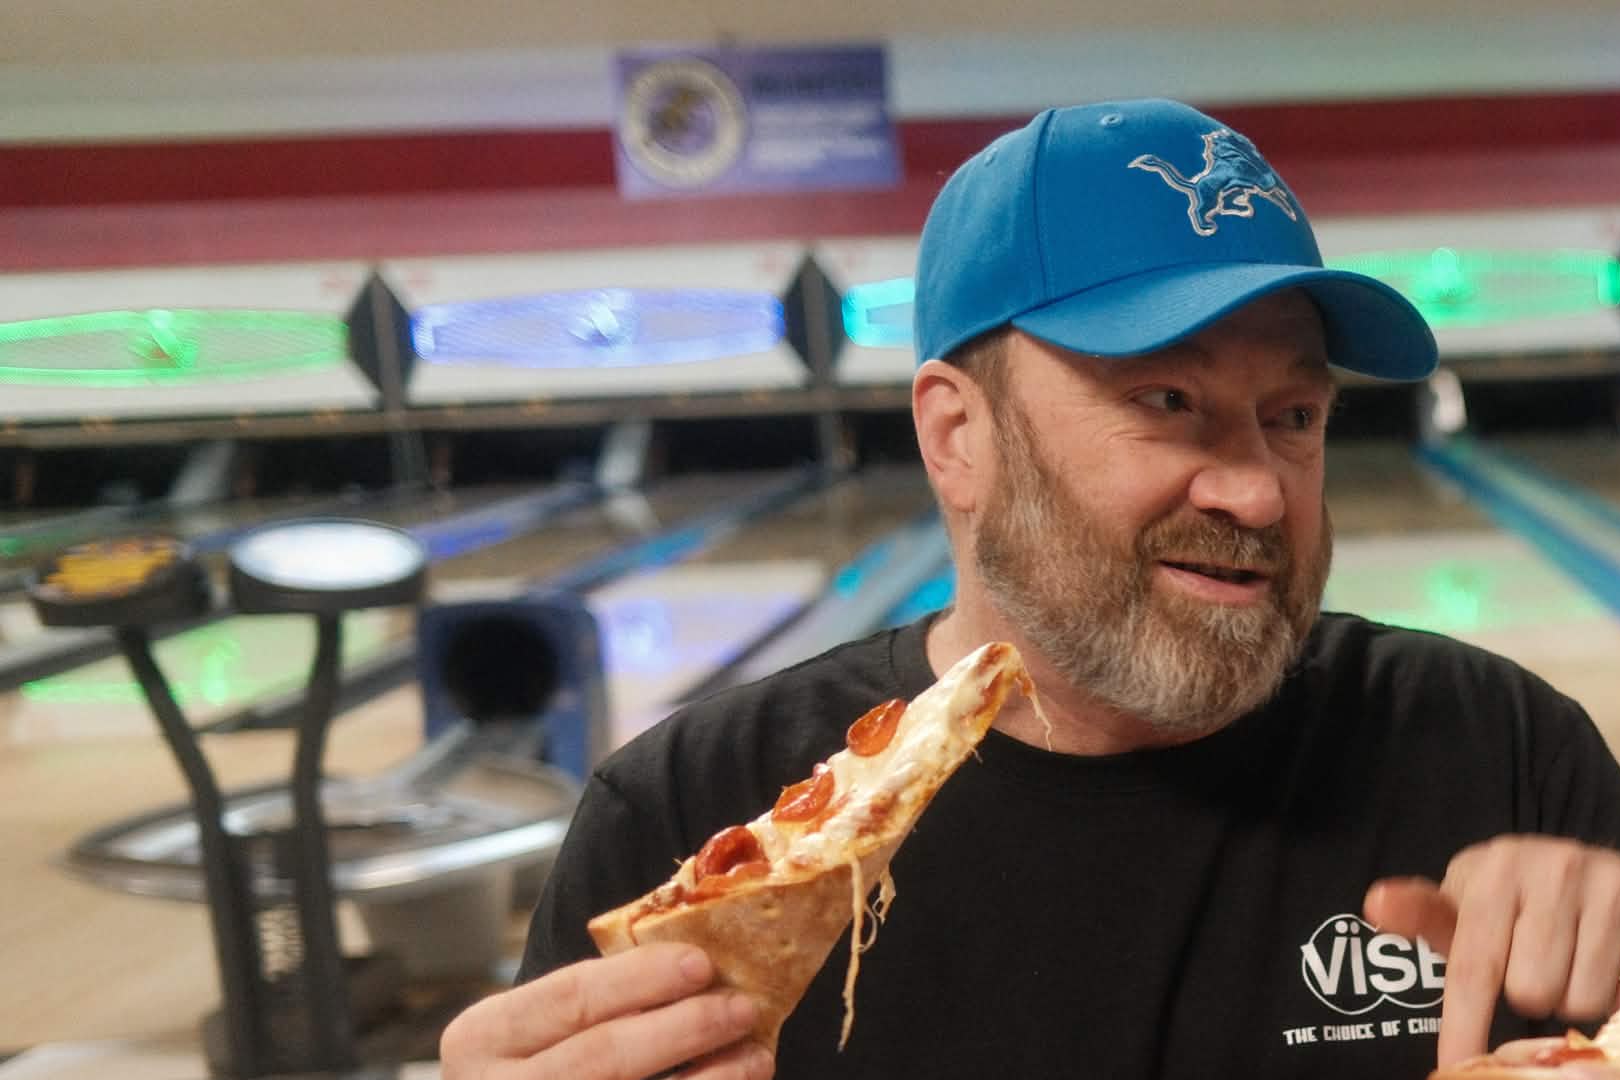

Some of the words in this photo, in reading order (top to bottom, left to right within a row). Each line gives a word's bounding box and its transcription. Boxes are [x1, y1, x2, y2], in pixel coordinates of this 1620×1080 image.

[1282, 1026, 1318, 1045] THE
[1322, 1023, 1376, 1041] CHOICE
[1381, 1019, 1400, 1037] OF
